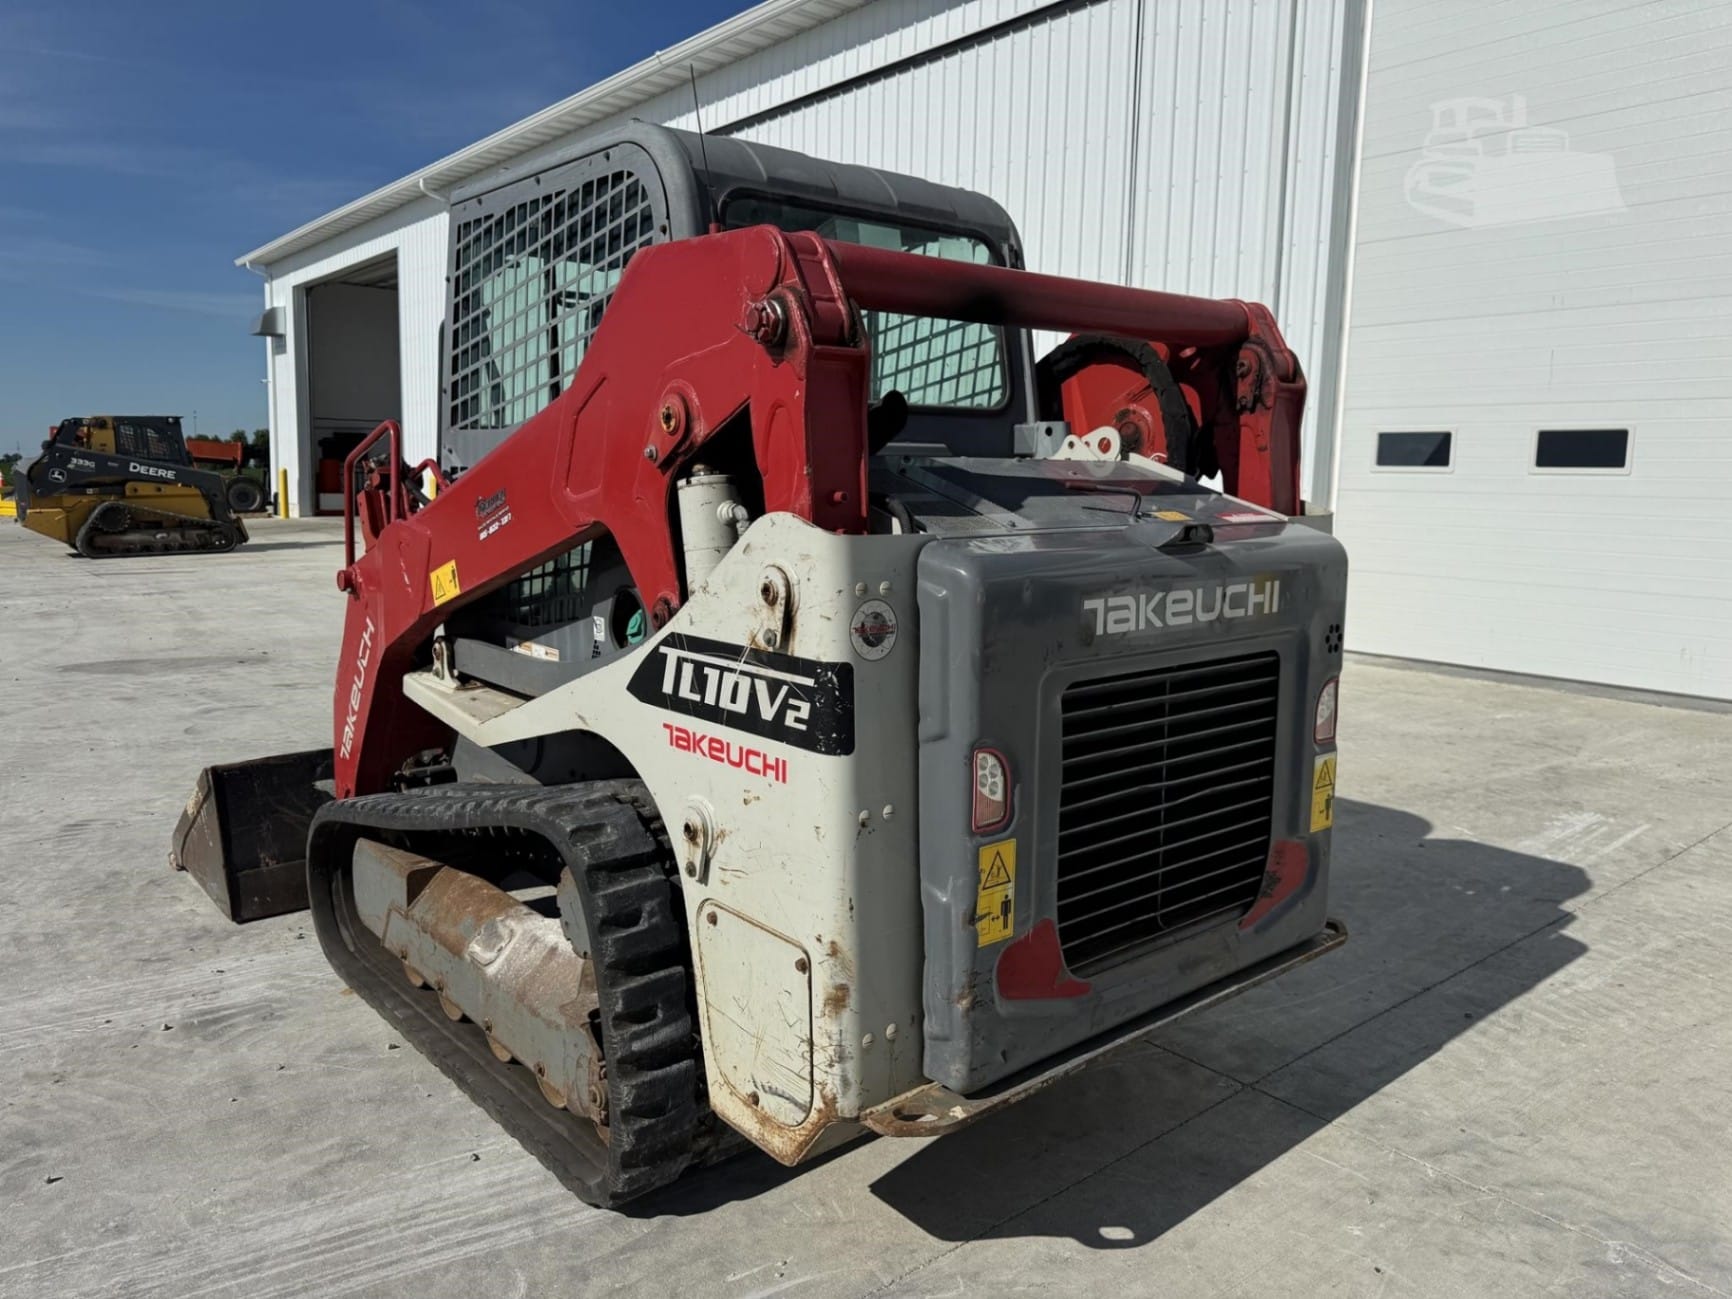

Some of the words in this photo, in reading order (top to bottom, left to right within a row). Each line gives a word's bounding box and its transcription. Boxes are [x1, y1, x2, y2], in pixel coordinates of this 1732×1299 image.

[129, 462, 176, 479] DEERE
[1083, 580, 1280, 636] TAKEUCHI
[662, 722, 788, 784] TAKEUCHI
